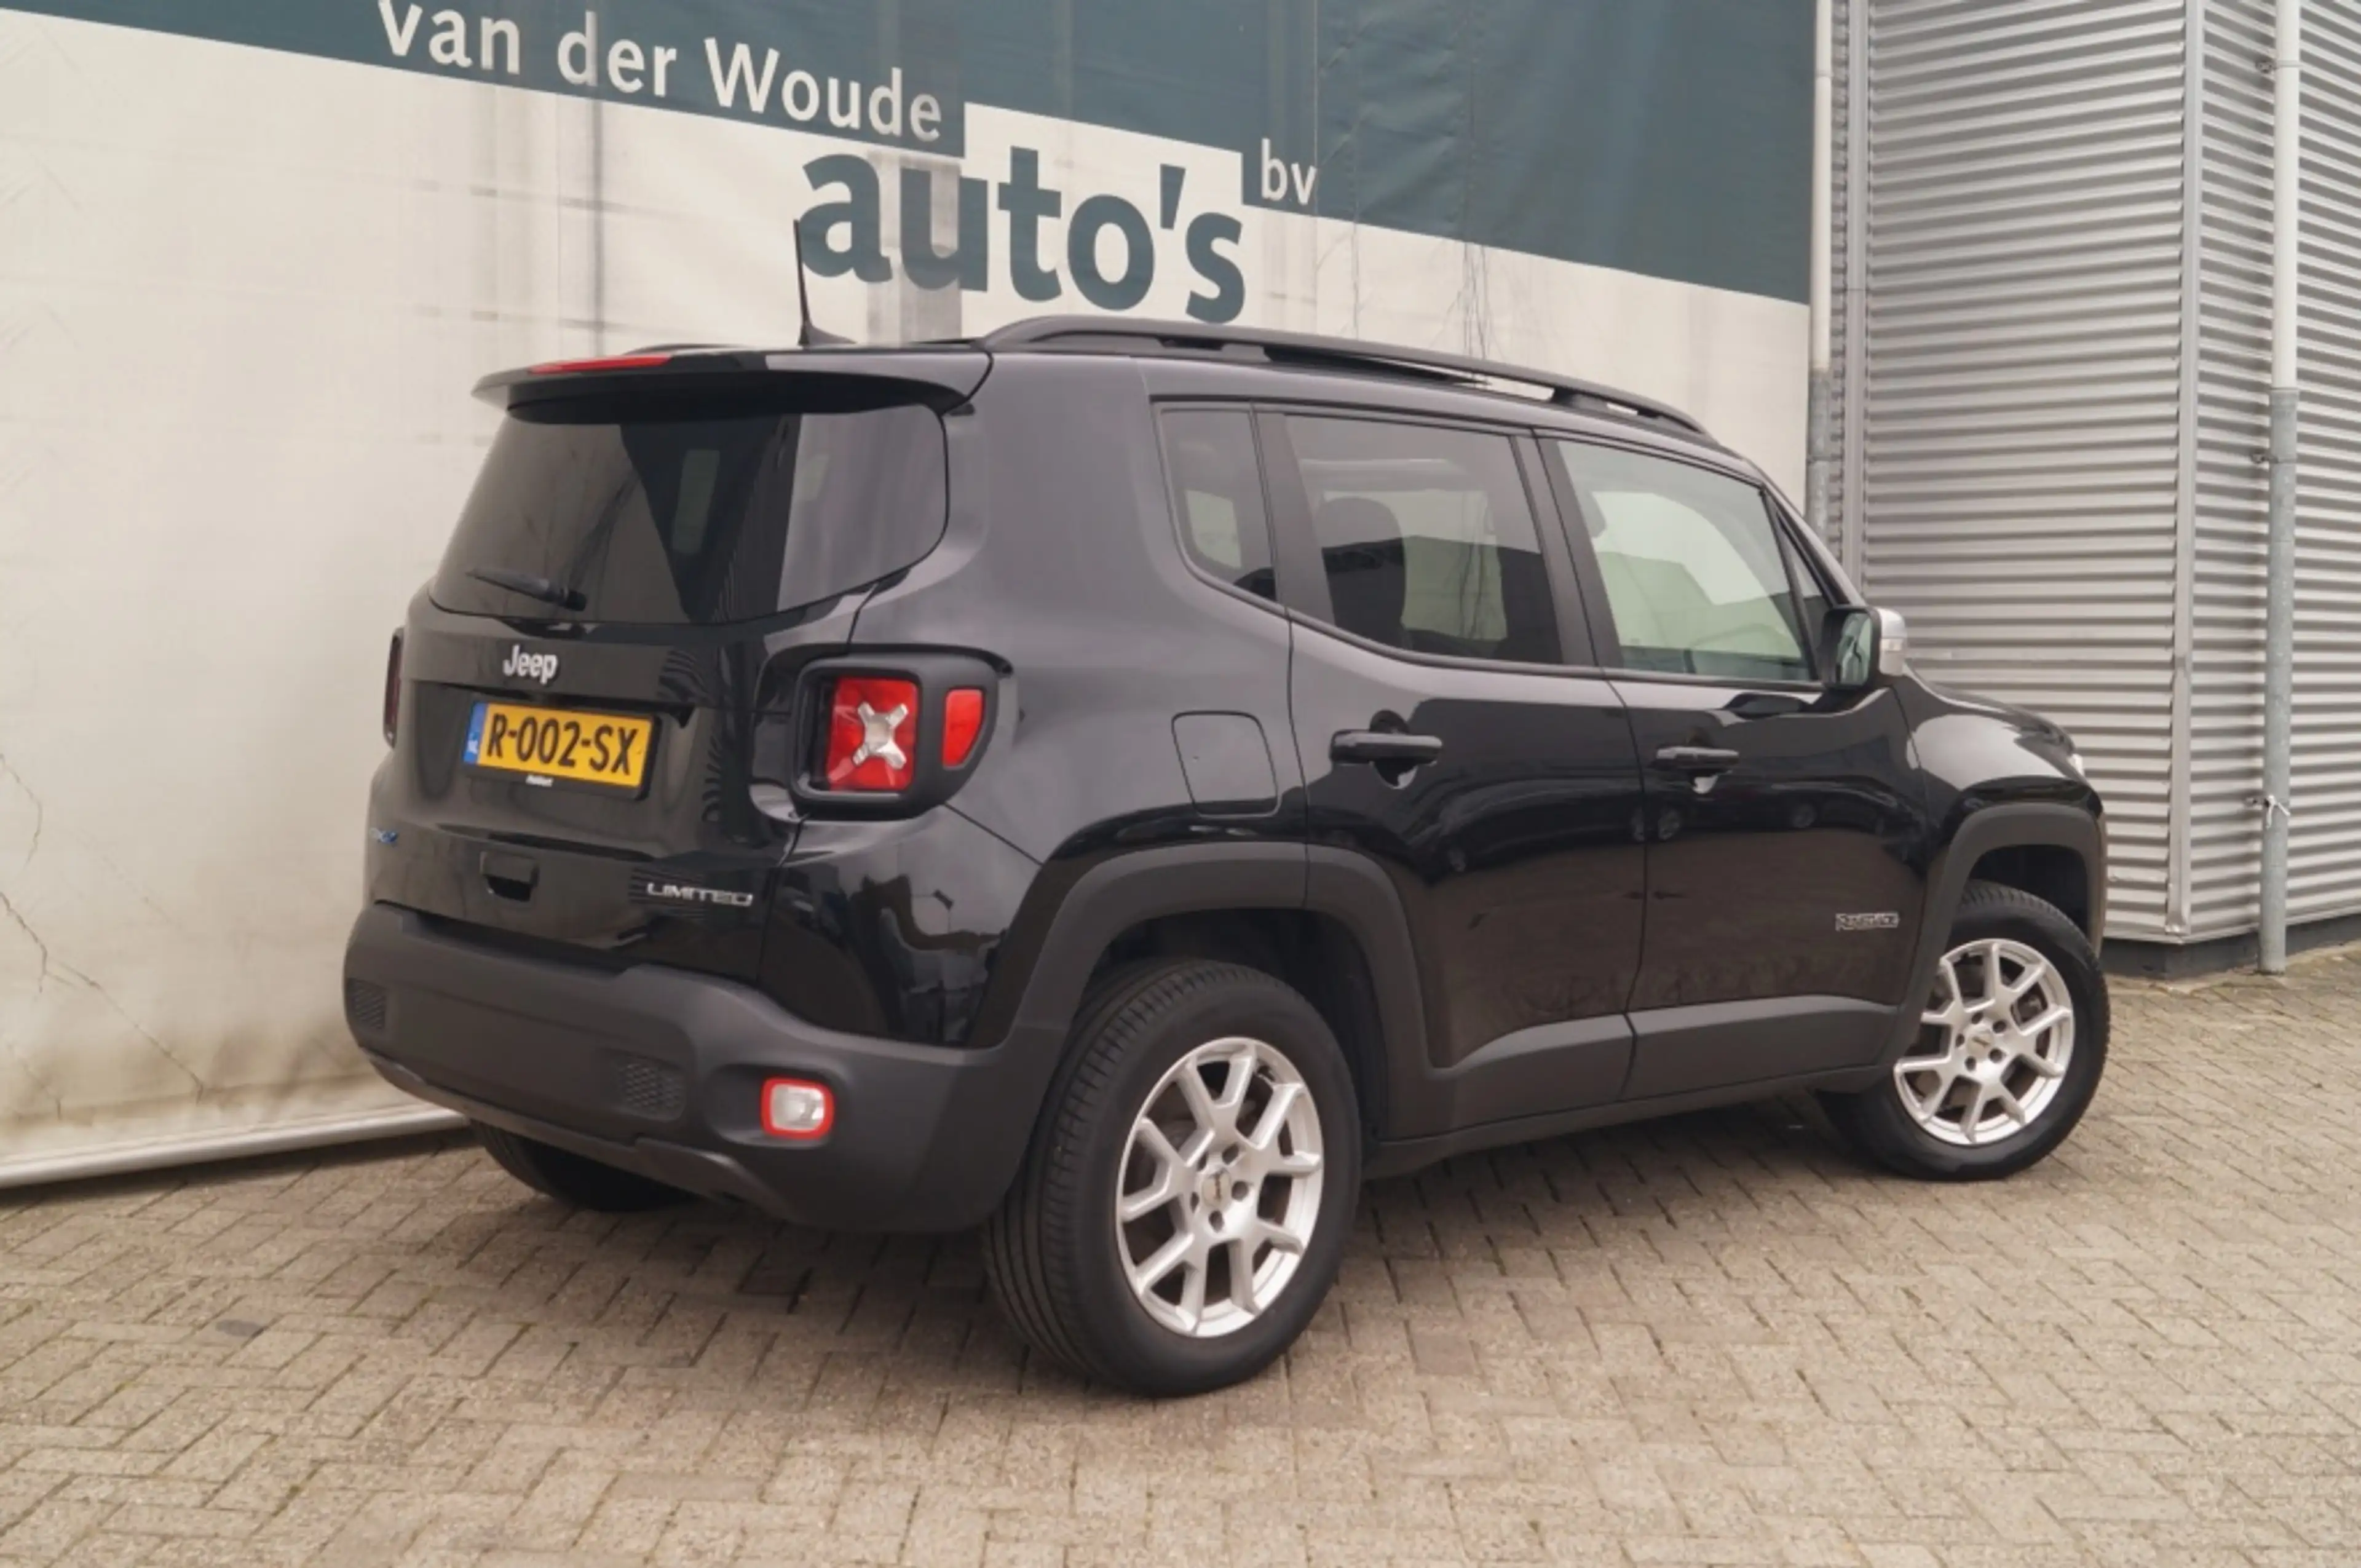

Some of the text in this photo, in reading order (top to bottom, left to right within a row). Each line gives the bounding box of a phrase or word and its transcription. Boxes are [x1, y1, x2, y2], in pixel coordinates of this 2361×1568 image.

[378, 0, 942, 141] van der Woude
[799, 138, 1317, 324] auto's bv
[503, 644, 558, 684] Jeep
[486, 712, 638, 776] R-002-SX
[647, 882, 753, 907] LIMITED
